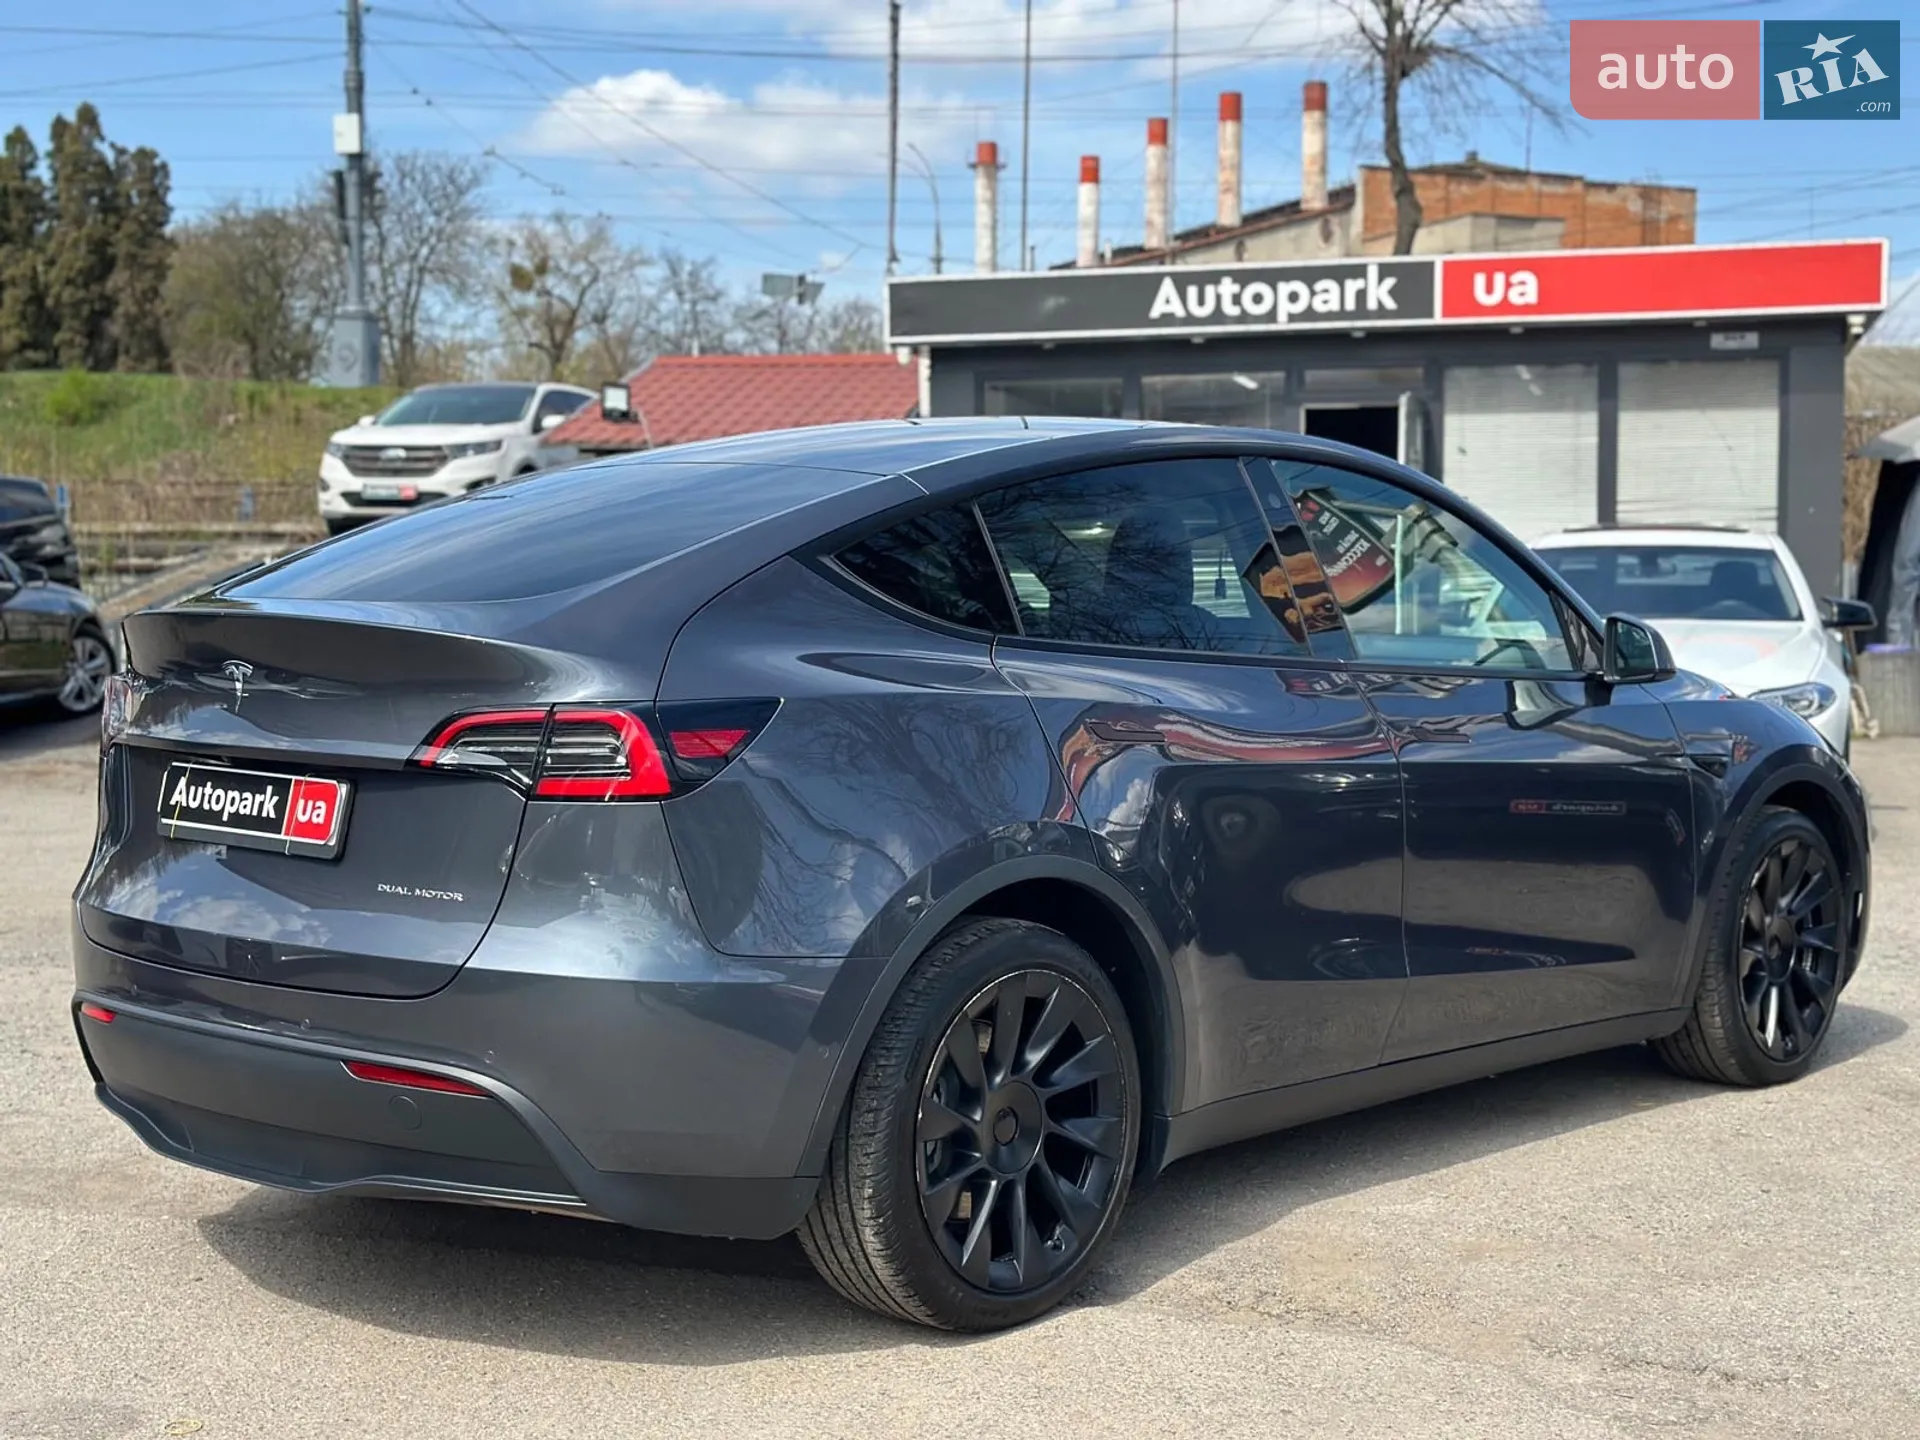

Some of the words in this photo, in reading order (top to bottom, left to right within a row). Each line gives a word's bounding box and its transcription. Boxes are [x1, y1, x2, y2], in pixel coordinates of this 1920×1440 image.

[1148, 263, 1398, 324] Autopark
[1473, 269, 1539, 306] ua
[169, 776, 280, 822] Autopark
[296, 797, 327, 825] ua
[377, 883, 412, 896] DUAL
[414, 888, 464, 902] MOTOR
